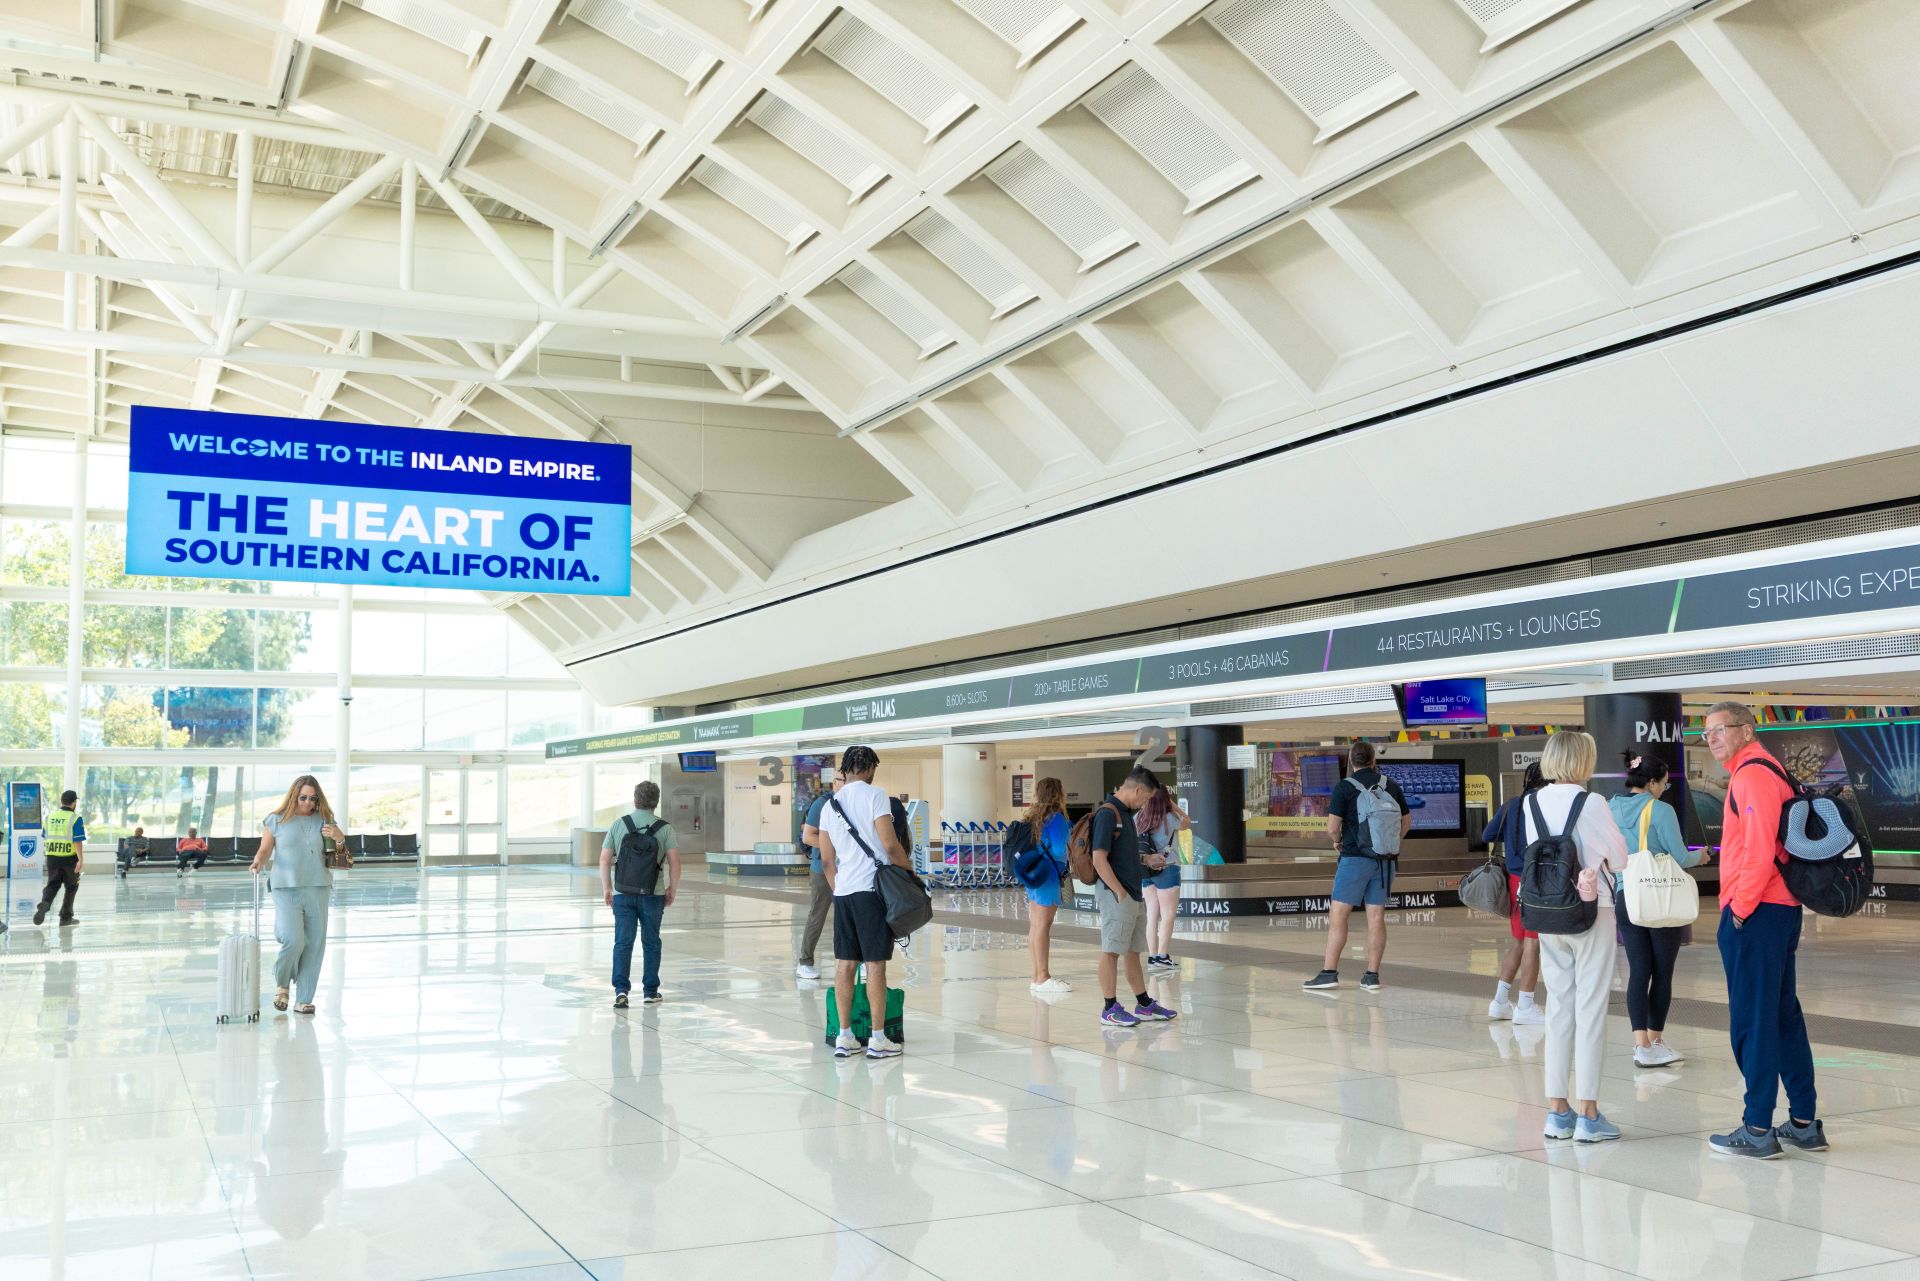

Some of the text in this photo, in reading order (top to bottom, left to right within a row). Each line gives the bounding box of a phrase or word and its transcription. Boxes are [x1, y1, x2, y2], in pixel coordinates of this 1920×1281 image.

[168, 432, 601, 482] WELCOME TO THE INLAND EMPIRE.
[167, 490, 593, 551] THE HEART OF
[165, 537, 600, 582] SOUTHERN CALIFORNIA.
[1747, 575, 1852, 609] STRIKING
[1377, 609, 1601, 653] 44 RESTAURANTS + LOUNGES
[1168, 649, 1290, 680] 3 POOLS + 46 CABANAS
[967, 690, 988, 705] SLOTS
[1034, 674, 1109, 696] 200+ TABLE GAMES
[872, 698, 896, 719] PALMS
[1420, 695, 1471, 704] Salt Lake City
[1635, 721, 1683, 742] PALM
[1134, 725, 1171, 772] 2
[758, 756, 784, 786] 3
[1190, 901, 1230, 914] PALMS
[1305, 898, 1331, 911] PALM
[1404, 893, 1436, 906] PALMS
